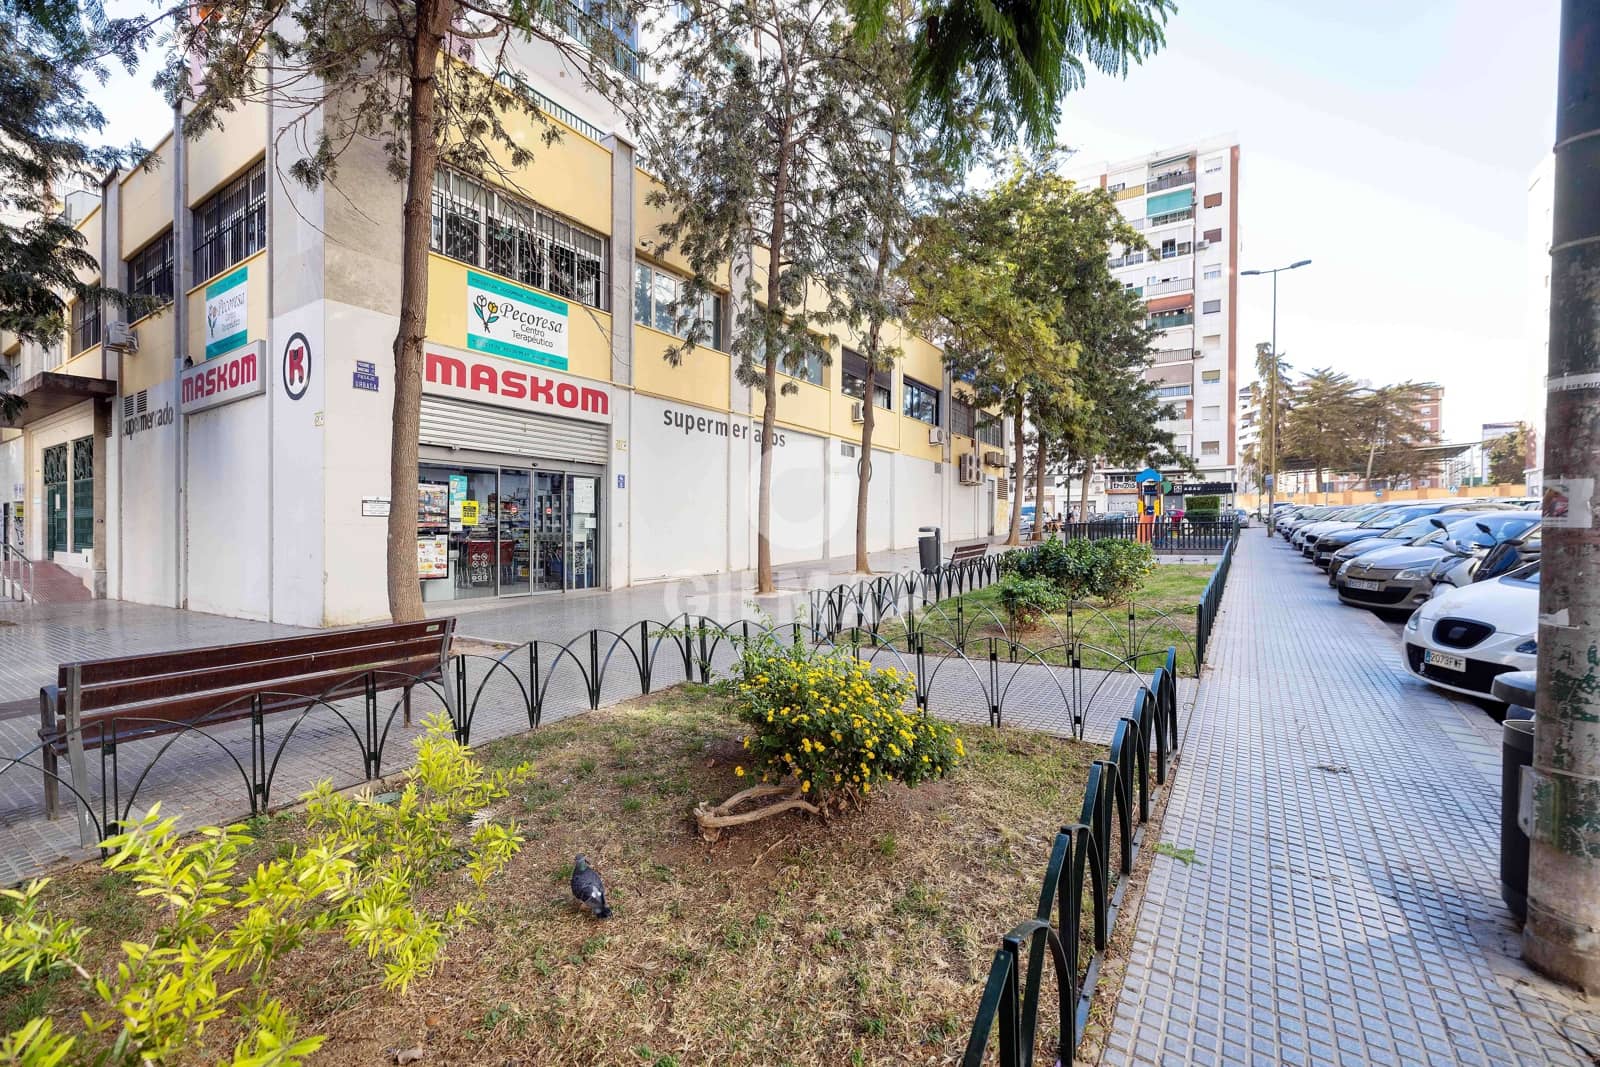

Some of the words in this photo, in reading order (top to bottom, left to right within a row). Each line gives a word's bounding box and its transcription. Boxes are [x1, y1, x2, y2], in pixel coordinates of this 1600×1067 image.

[500, 302, 564, 334] Pecoresa
[520, 324, 545, 337] Centro
[512, 329, 554, 348] Terapéutico
[182, 353, 257, 404] MASKOM
[426, 352, 609, 415] MASKOM
